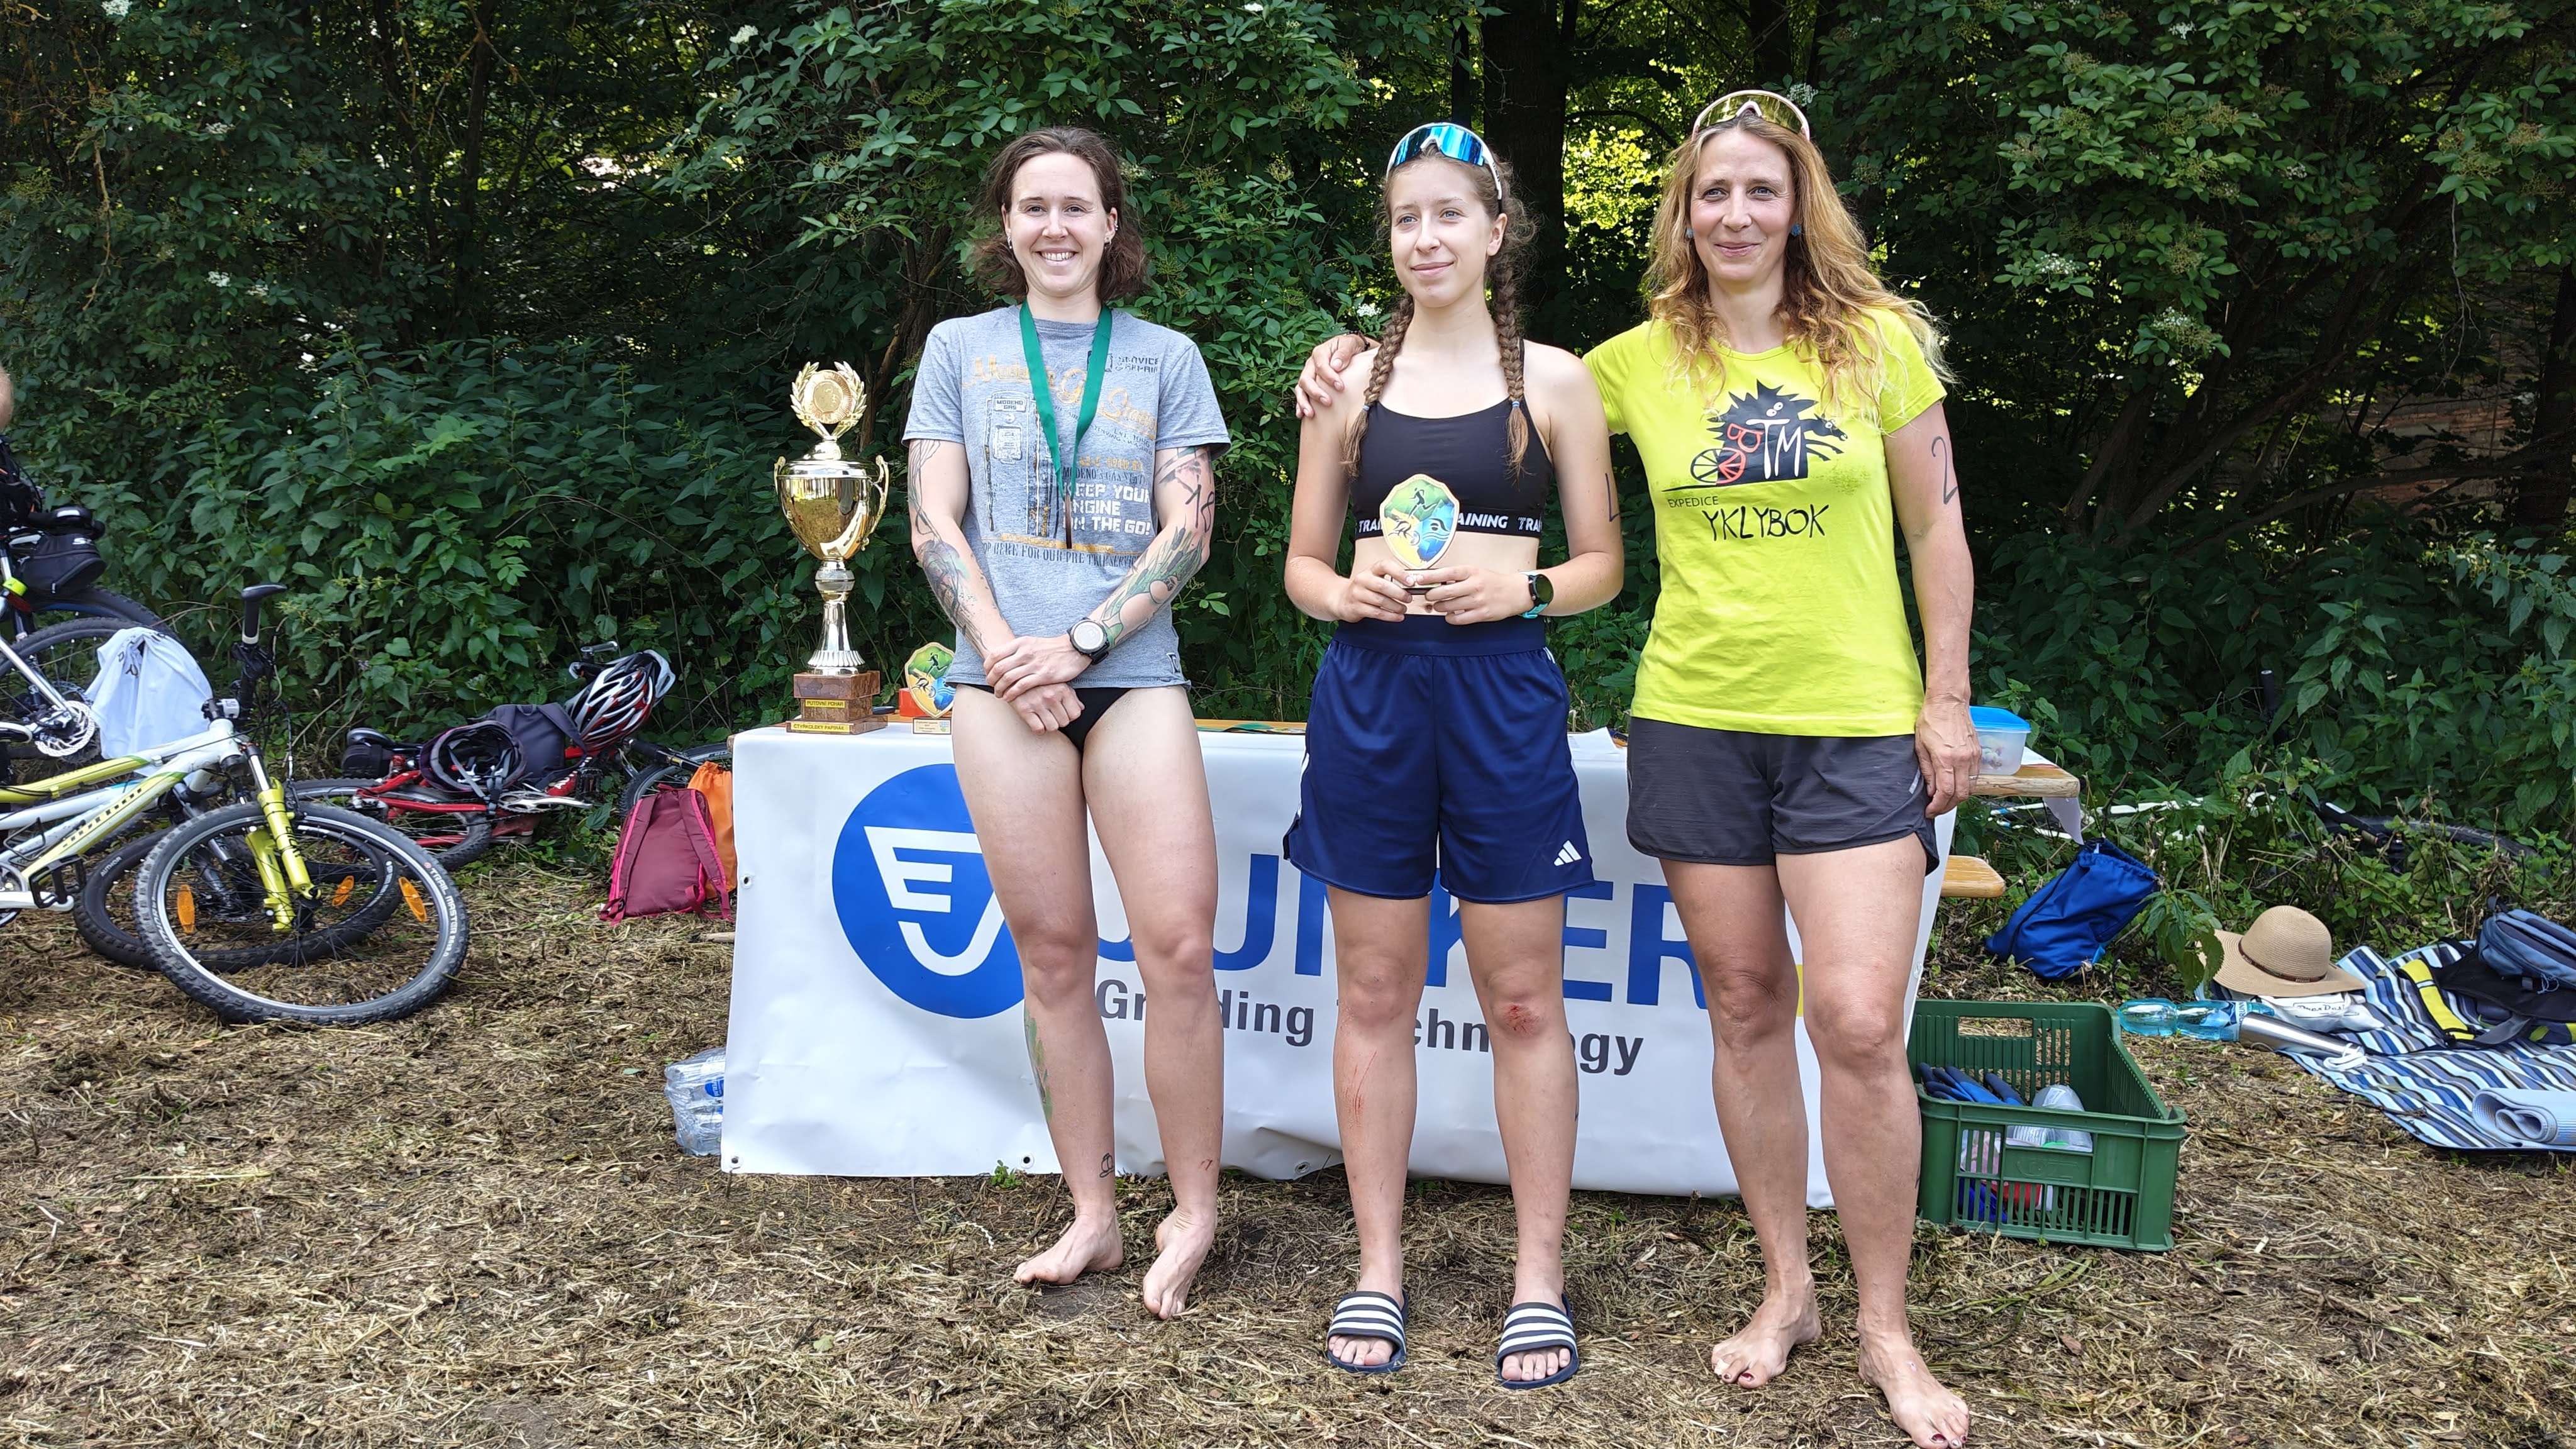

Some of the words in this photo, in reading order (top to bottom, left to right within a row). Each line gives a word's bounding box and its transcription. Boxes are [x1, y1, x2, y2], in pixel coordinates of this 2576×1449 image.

[1063, 499, 1121, 516] NGINE
[1185, 484, 1215, 533] 18
[1668, 496, 1719, 508] EXPEDICE
[1091, 516, 1122, 533] THE
[1124, 519, 1152, 536] GO!
[1702, 503, 1829, 541] YKLYBOK
[1021, 545, 1040, 560] FOR
[1043, 549, 1062, 562] OUR
[1066, 551, 1085, 564] PRE
[100, 857, 122, 877] AUTHOR
[430, 867, 449, 895] TRAIL
[445, 895, 458, 935] MASTER
